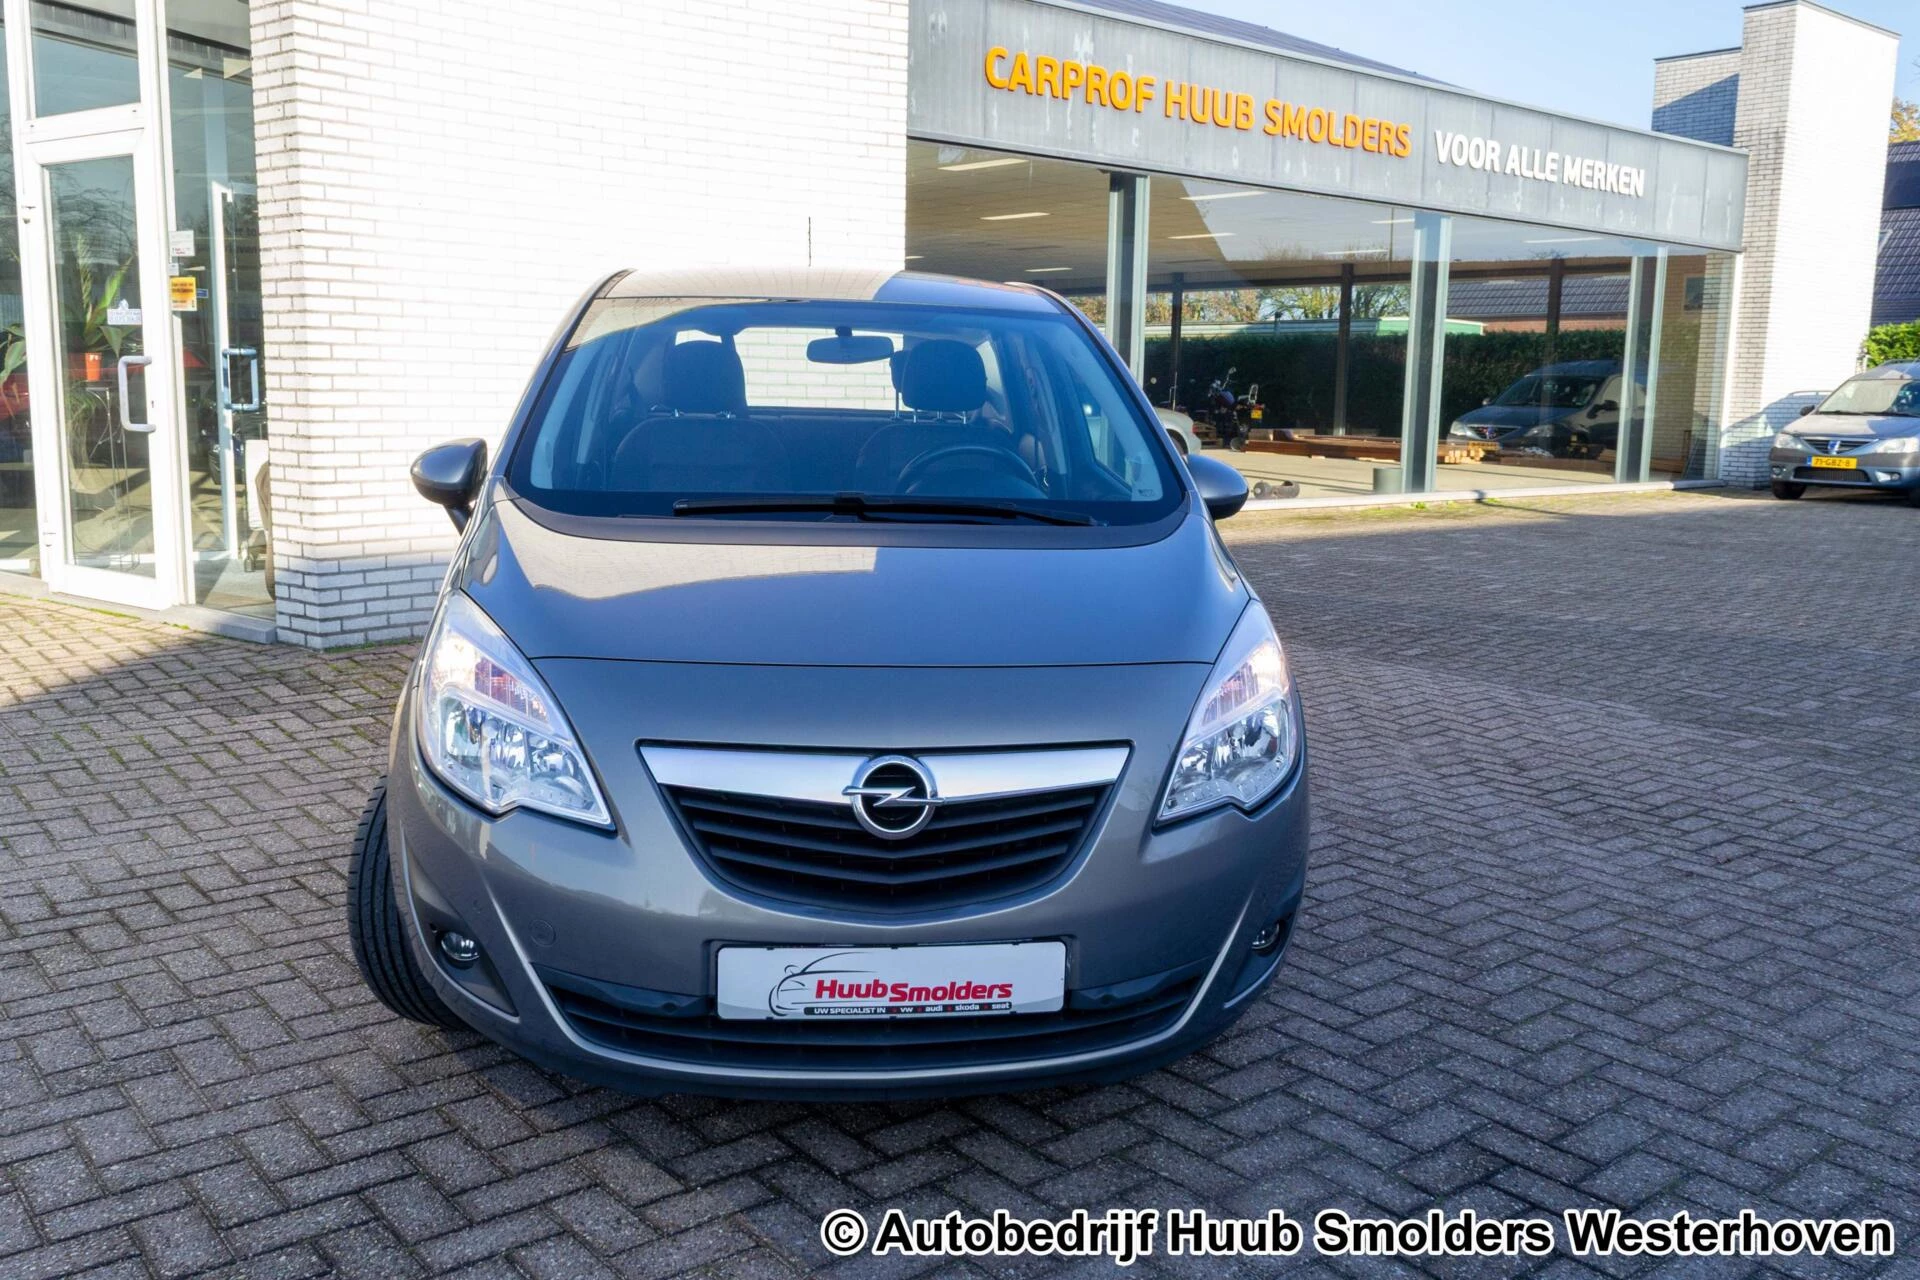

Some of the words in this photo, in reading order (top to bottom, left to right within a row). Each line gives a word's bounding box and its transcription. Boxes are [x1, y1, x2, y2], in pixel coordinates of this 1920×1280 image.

[985, 46, 1156, 113] CARPROF
[1165, 79, 1255, 130] HUUB
[1263, 98, 1412, 158] SMOLDERS
[1435, 129, 1501, 174] VOOR
[1504, 144, 1560, 183] ALLE
[1562, 154, 1645, 198] MERKEN
[814, 1007, 829, 1015] UW
[829, 1006, 876, 1015] SPECIALIST
[876, 1006, 886, 1014] IN
[925, 1004, 943, 1013] audi
[955, 1003, 980, 1012] skoda
[991, 1001, 1010, 1010] seat
